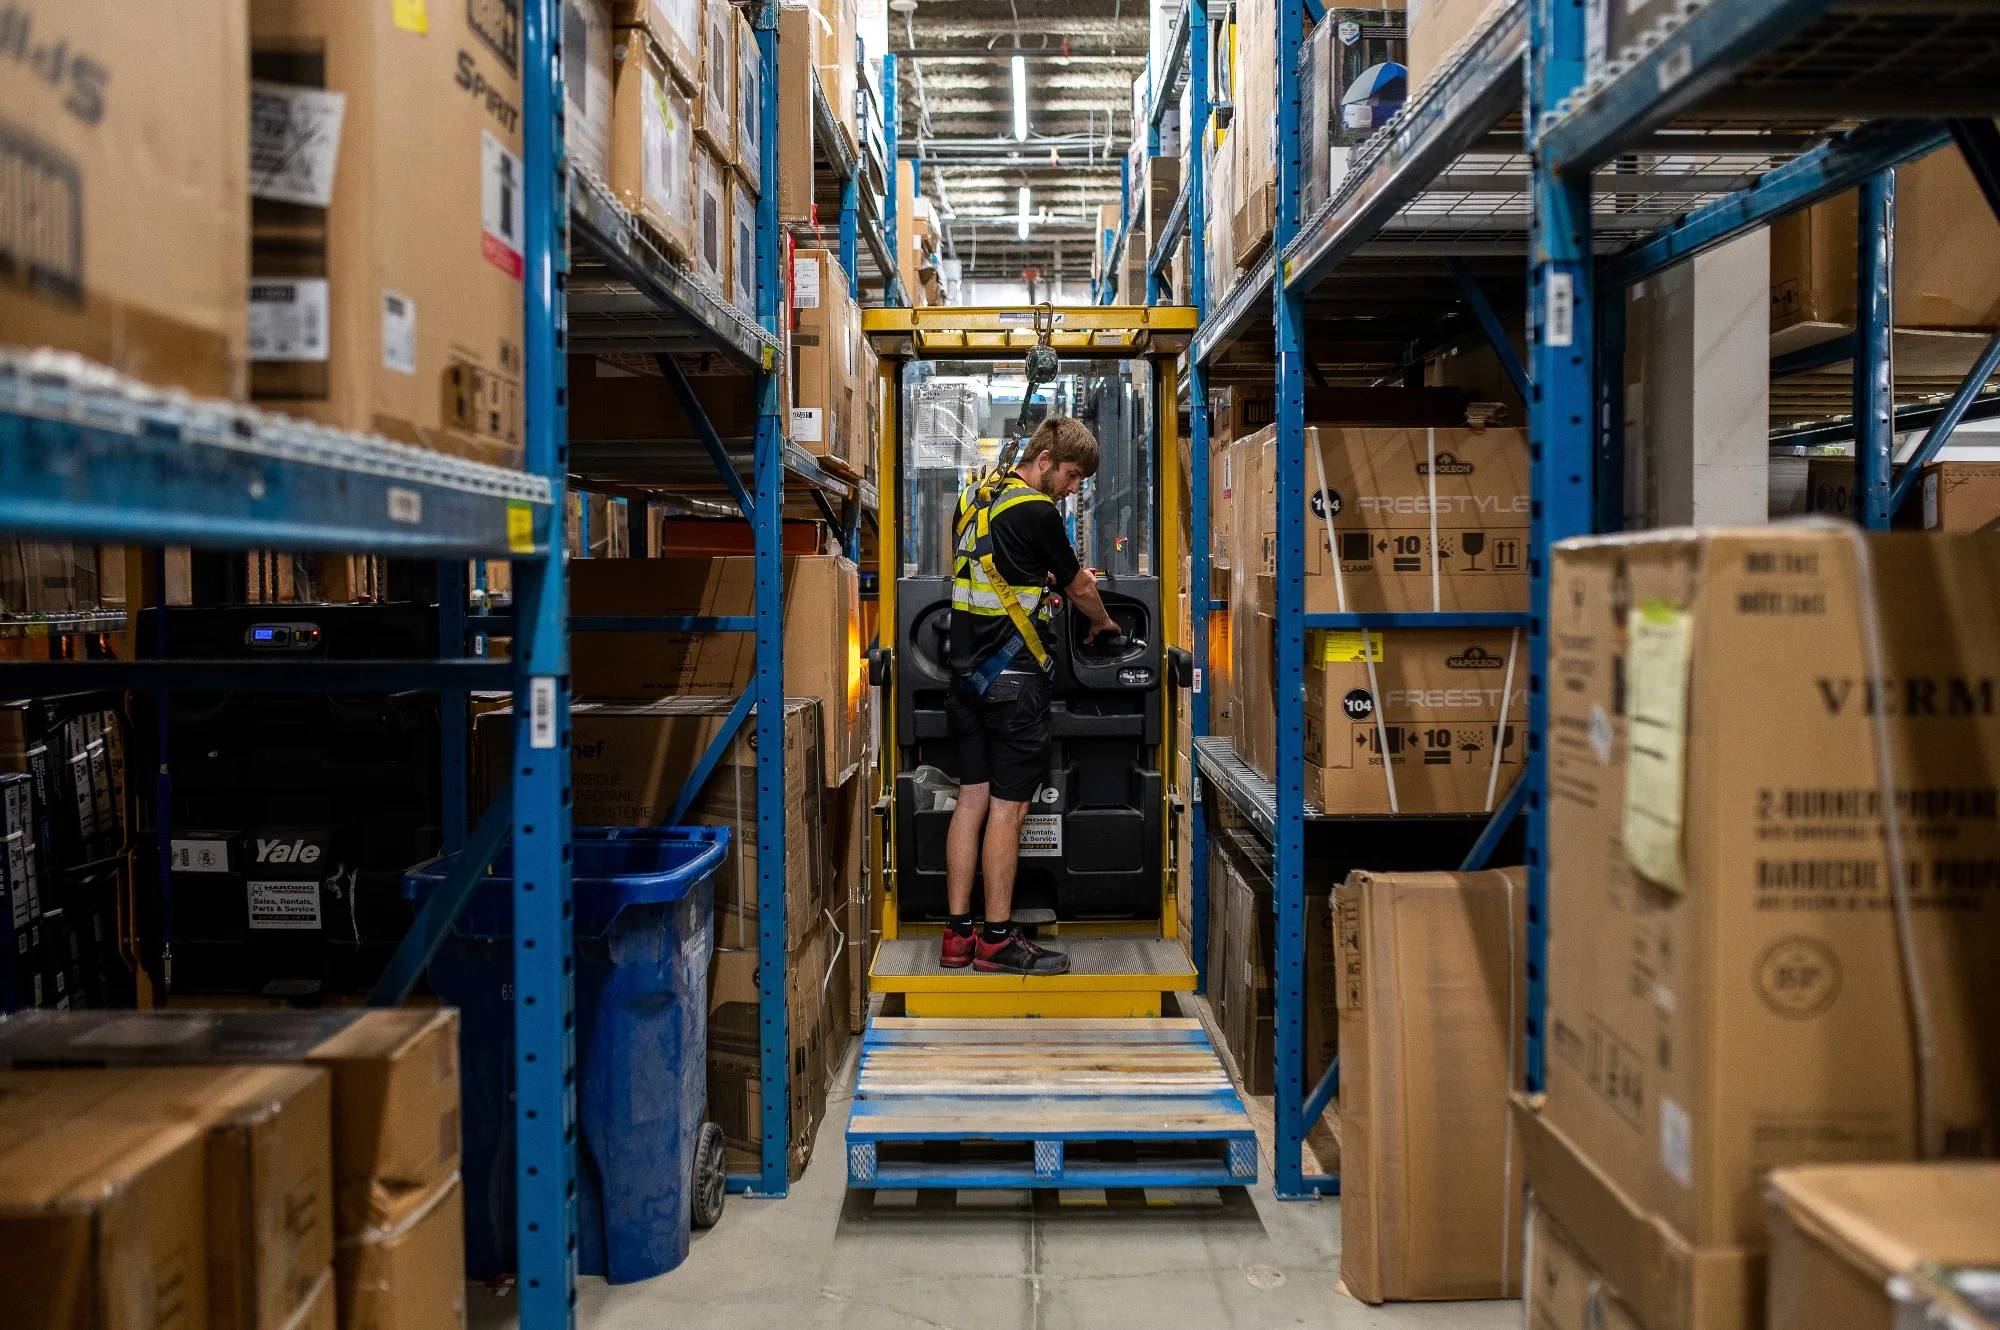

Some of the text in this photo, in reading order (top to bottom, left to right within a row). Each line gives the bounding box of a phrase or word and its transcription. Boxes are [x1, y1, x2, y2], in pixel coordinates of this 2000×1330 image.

[1393, 535, 1421, 555] 10
[1340, 564, 1373, 573] CLAMP
[1449, 658, 1502, 668] NAPOLEON
[1424, 729, 1451, 748] 10
[575, 789, 635, 802] PROPANE
[1026, 829, 1056, 837] Rentals,
[256, 838, 321, 864] Yale
[253, 898, 314, 906] Sales, Rentals,
[284, 905, 315, 913] Service
